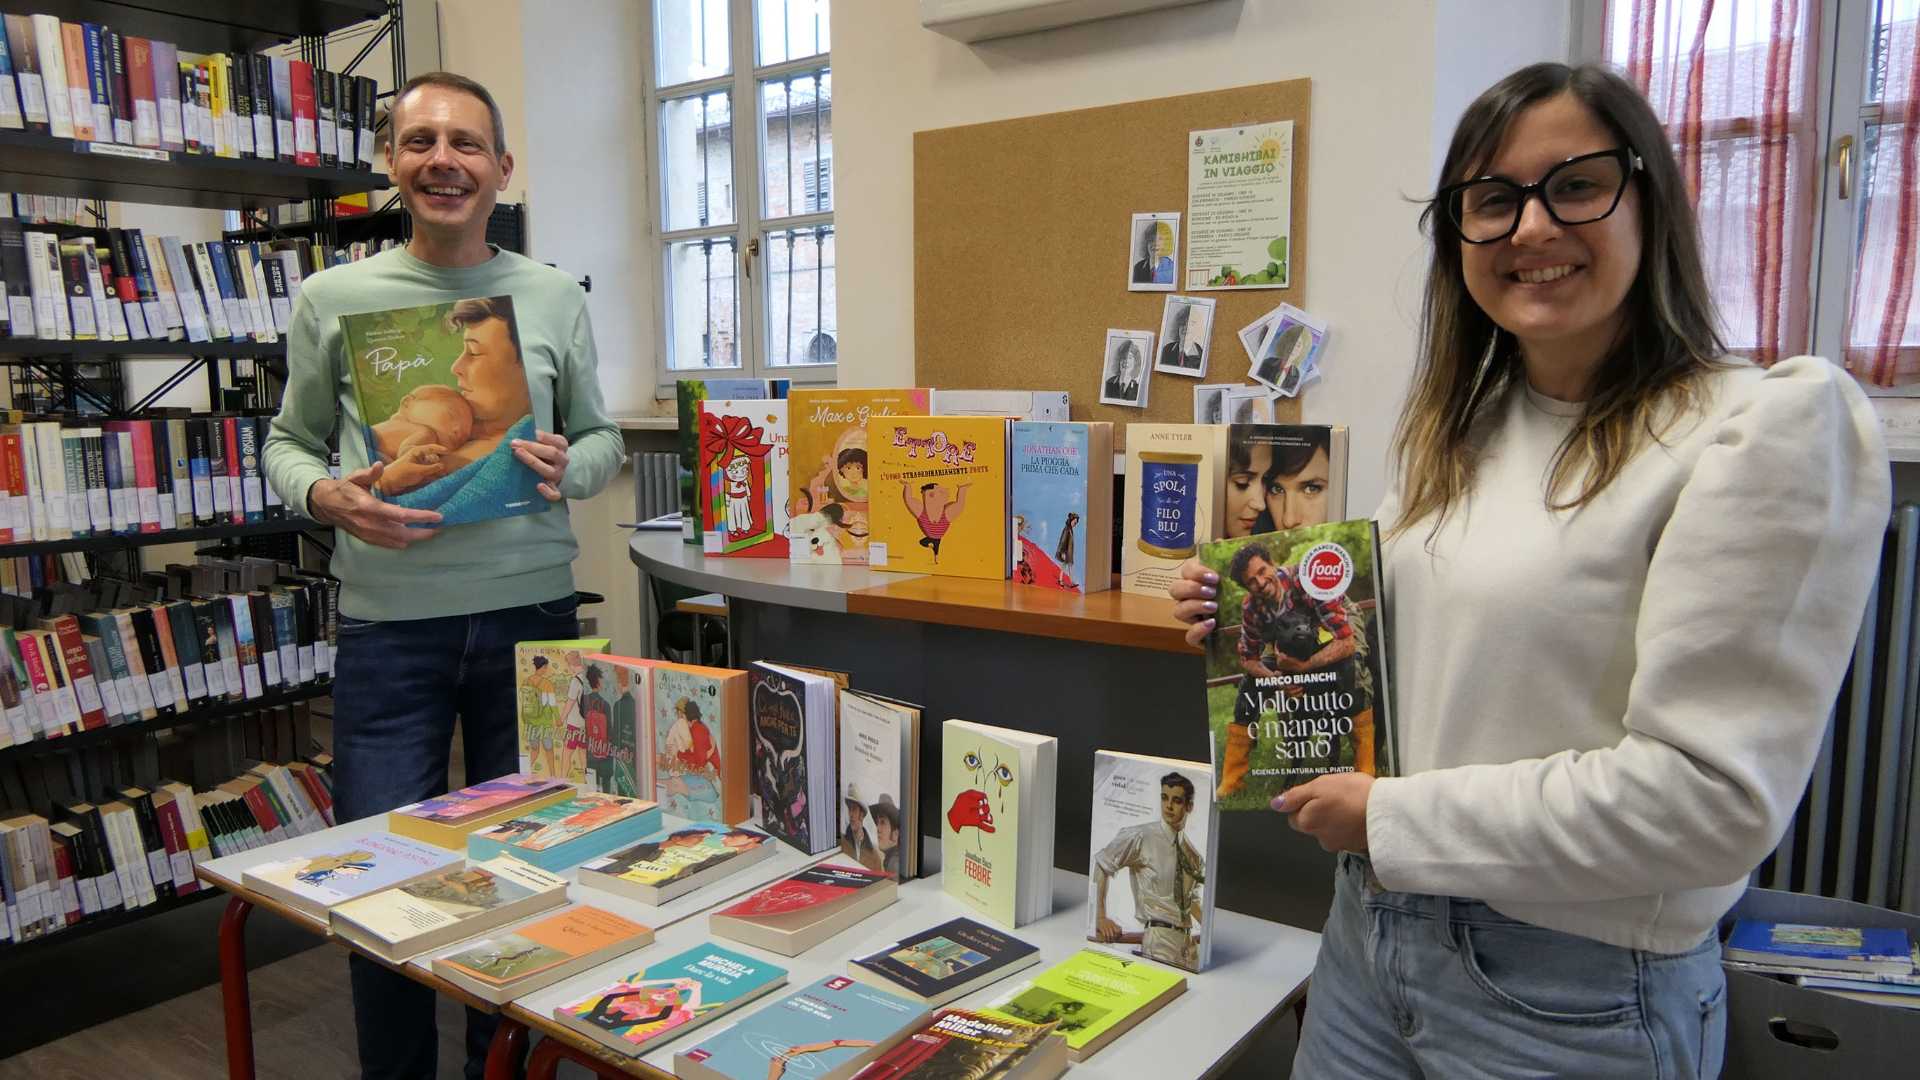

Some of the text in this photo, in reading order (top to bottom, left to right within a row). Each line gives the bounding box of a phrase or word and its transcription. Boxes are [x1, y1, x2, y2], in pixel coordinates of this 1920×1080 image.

[1204, 148, 1277, 165] KAMISHIBAI
[1204, 163, 1275, 179] IN VIAGGIO
[810, 406, 845, 428] Max
[846, 412, 856, 423] e
[1150, 432, 1193, 442] ANNE TYLER
[893, 426, 977, 467] ETTORE
[1031, 456, 1040, 465] LA
[1021, 464, 1080, 476] PRIMA CHE CADA
[1153, 480, 1186, 496] SPOLA
[1156, 508, 1181, 520] FILO
[1158, 521, 1178, 532] BLU
[1310, 559, 1343, 580] food
[1255, 672, 1337, 687] MARCO BIANCHI
[1244, 690, 1353, 716] Mollo tutto
[1247, 711, 1353, 744] e mangio
[1275, 739, 1331, 760] sano
[1251, 768, 1280, 776] SCIENZA
[1287, 767, 1314, 775] NATURA
[964, 858, 992, 888] FEBBRE
[697, 960, 742, 979] MURGIA
[703, 954, 755, 975] MICHELA
[934, 1020, 982, 1038] Miller
[943, 1014, 1013, 1036] Madeline
